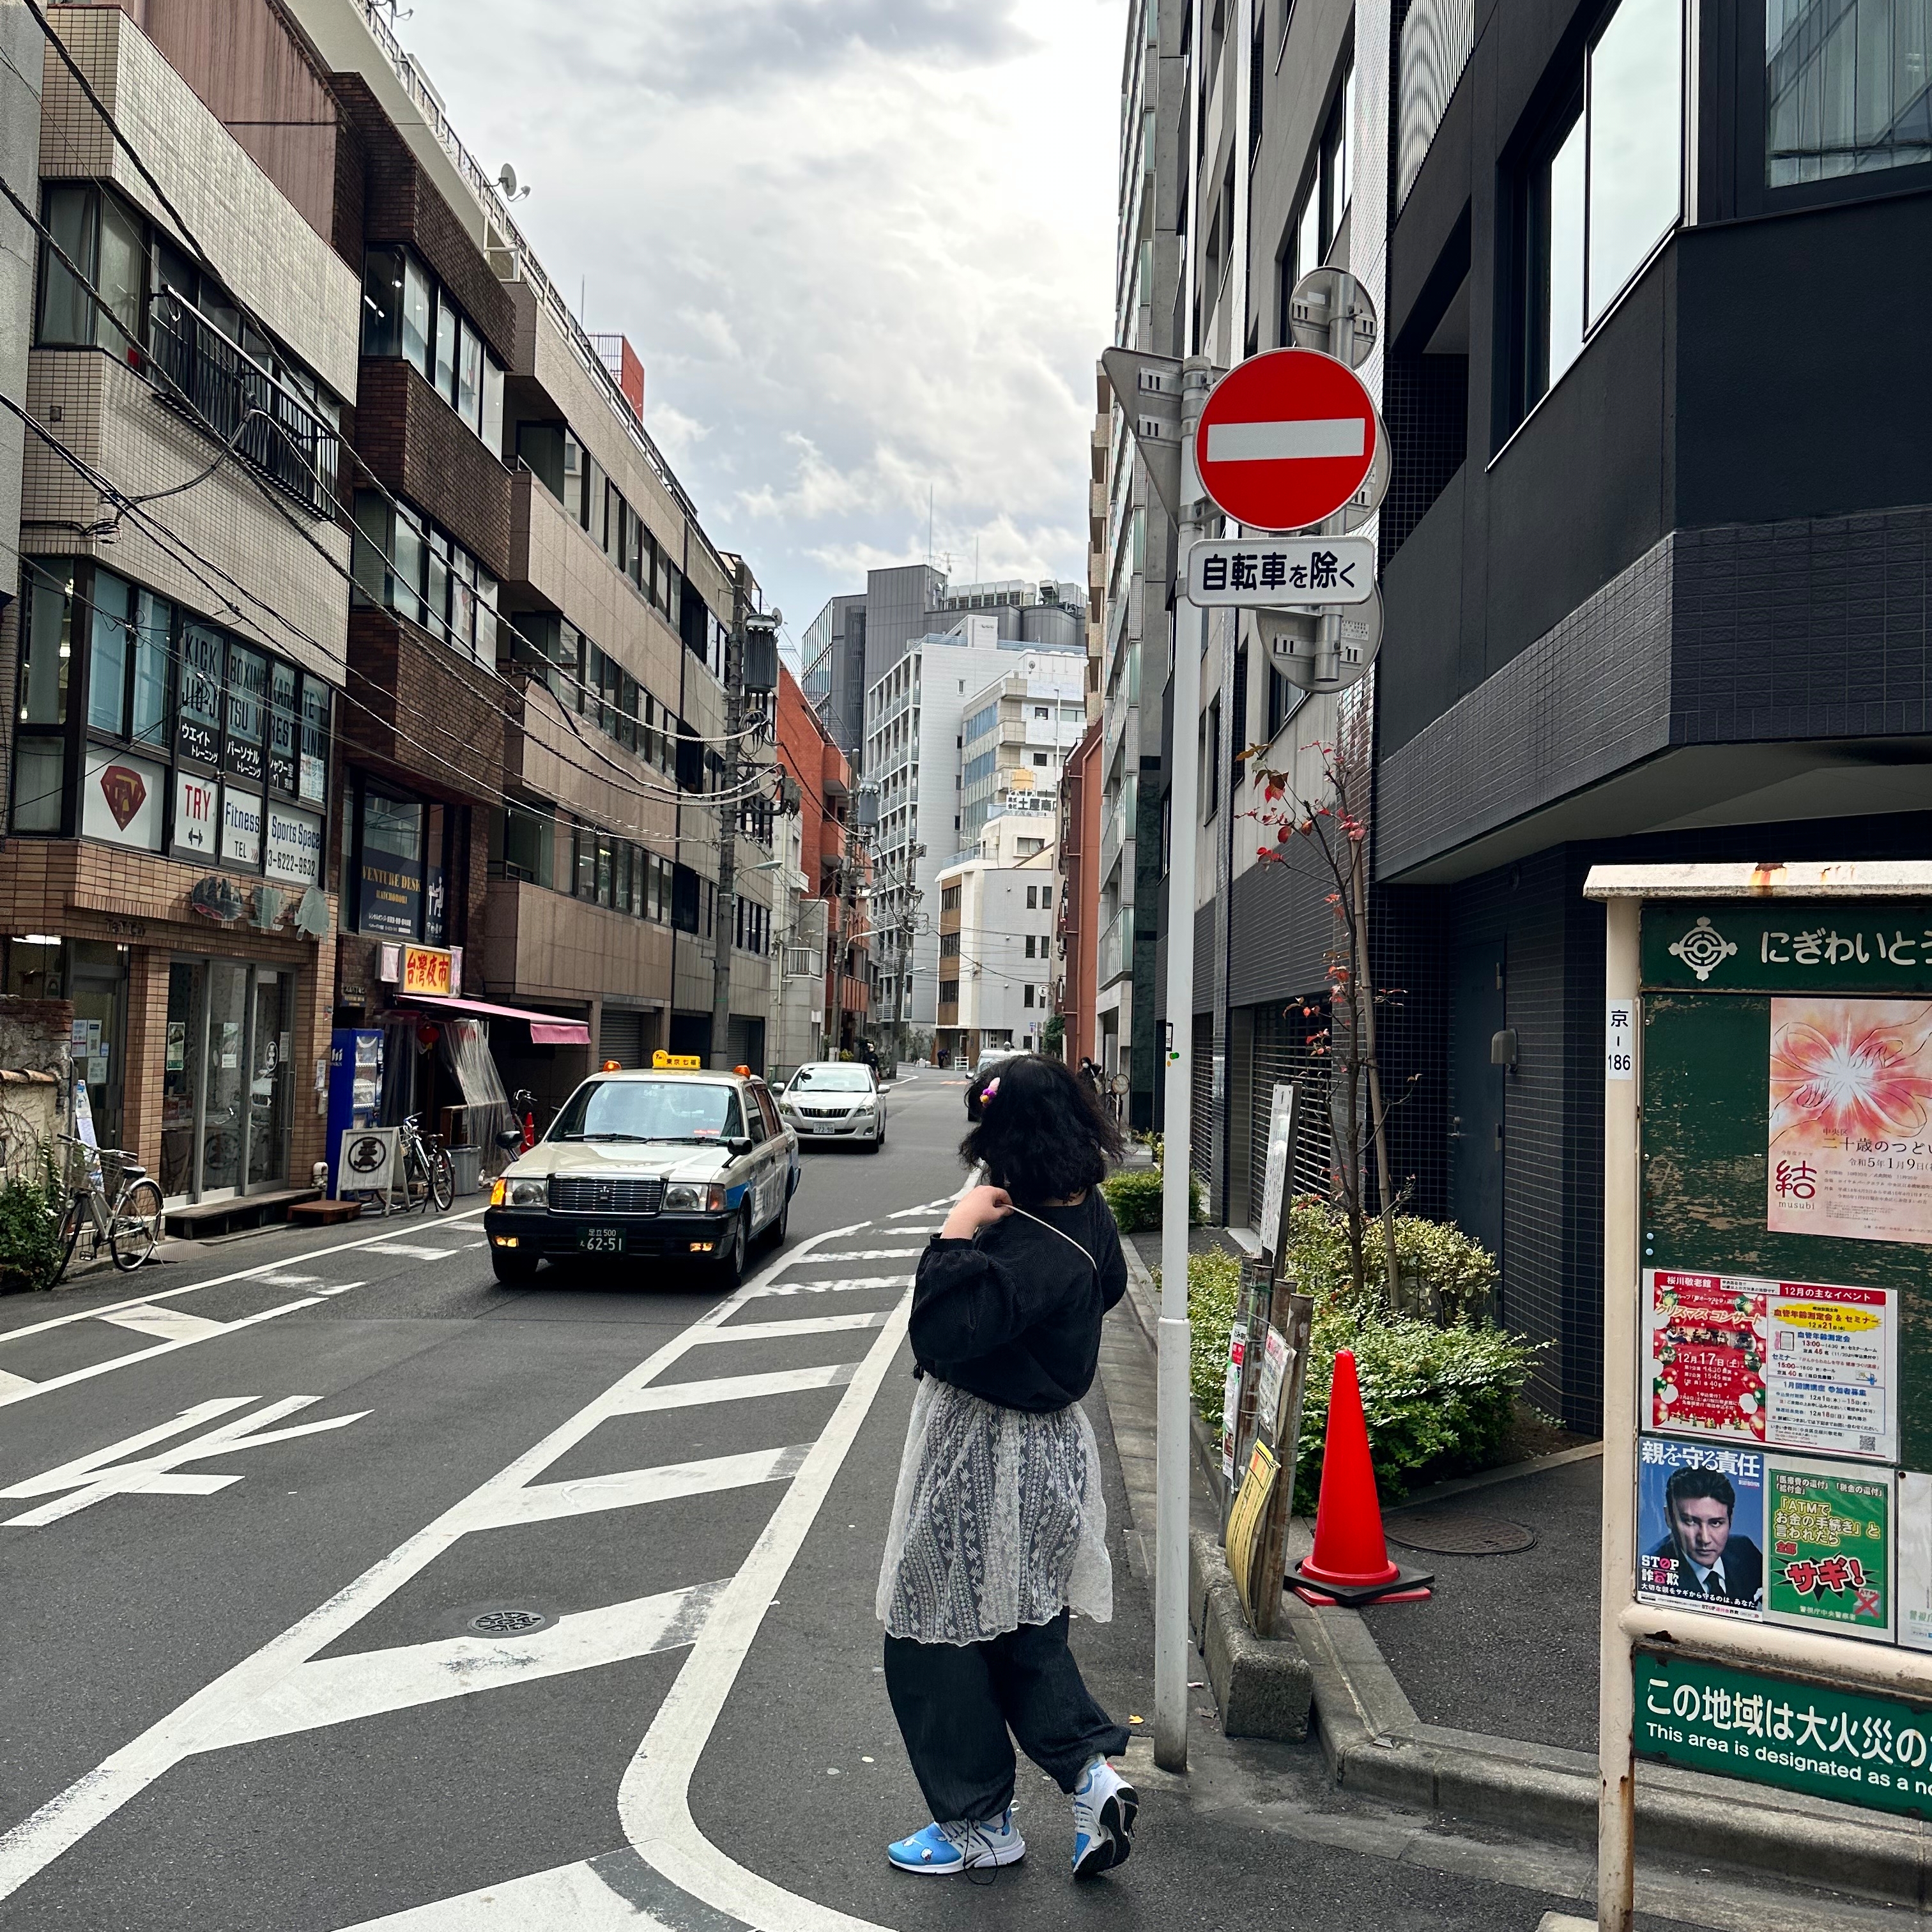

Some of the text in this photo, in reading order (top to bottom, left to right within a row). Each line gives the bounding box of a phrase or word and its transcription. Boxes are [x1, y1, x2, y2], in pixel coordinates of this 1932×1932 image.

[1203, 551, 1356, 591] 自転車を除く
[185, 633, 217, 676] KICK
[192, 745, 218, 763] トレーニング
[227, 741, 259, 764] パーソナル
[237, 760, 261, 778] トレーニング
[185, 785, 320, 852] TRY Fitness Sports Space
[234, 841, 247, 858] TEL
[362, 865, 421, 892] VENTURE DESK
[1776, 1160, 1817, 1199] 結
[1779, 1200, 1814, 1210] musubi
[603, 1229, 617, 1237] 500
[587, 1237, 622, 1251] 62-51
[1667, 1275, 1712, 1288] 桜川敬老館
[1784, 1287, 1871, 1301] 12月の主なイベント
[1656, 1305, 1762, 1325] クリスマス コンサート
[1774, 1309, 1833, 1321] 血管年齢測定会
[1845, 1315, 1880, 1324] セミナー
[1798, 1331, 1851, 1342] 血管年齢測定会
[1642, 1441, 1760, 1478] 親を守る責任
[1782, 1498, 1830, 1516] 「ATMで
[1776, 1524, 1839, 1546] 言われたら
[1776, 1542, 1797, 1554] 全部
[1641, 1555, 1679, 1570] STOP
[1788, 1556, 1864, 1593] サギ!
[1641, 1583, 1758, 1609] 大切な親をサギから守るのは、あなた。
[1646, 1678, 1932, 1772] この地域は大火災の
[1646, 1722, 1683, 1742] This
[1688, 1734, 1728, 1752] area
[1735, 1740, 1749, 1757] is
[1755, 1746, 1862, 1781] designated
[1867, 1771, 1890, 1787] as
[1896, 1777, 1908, 1791] a
